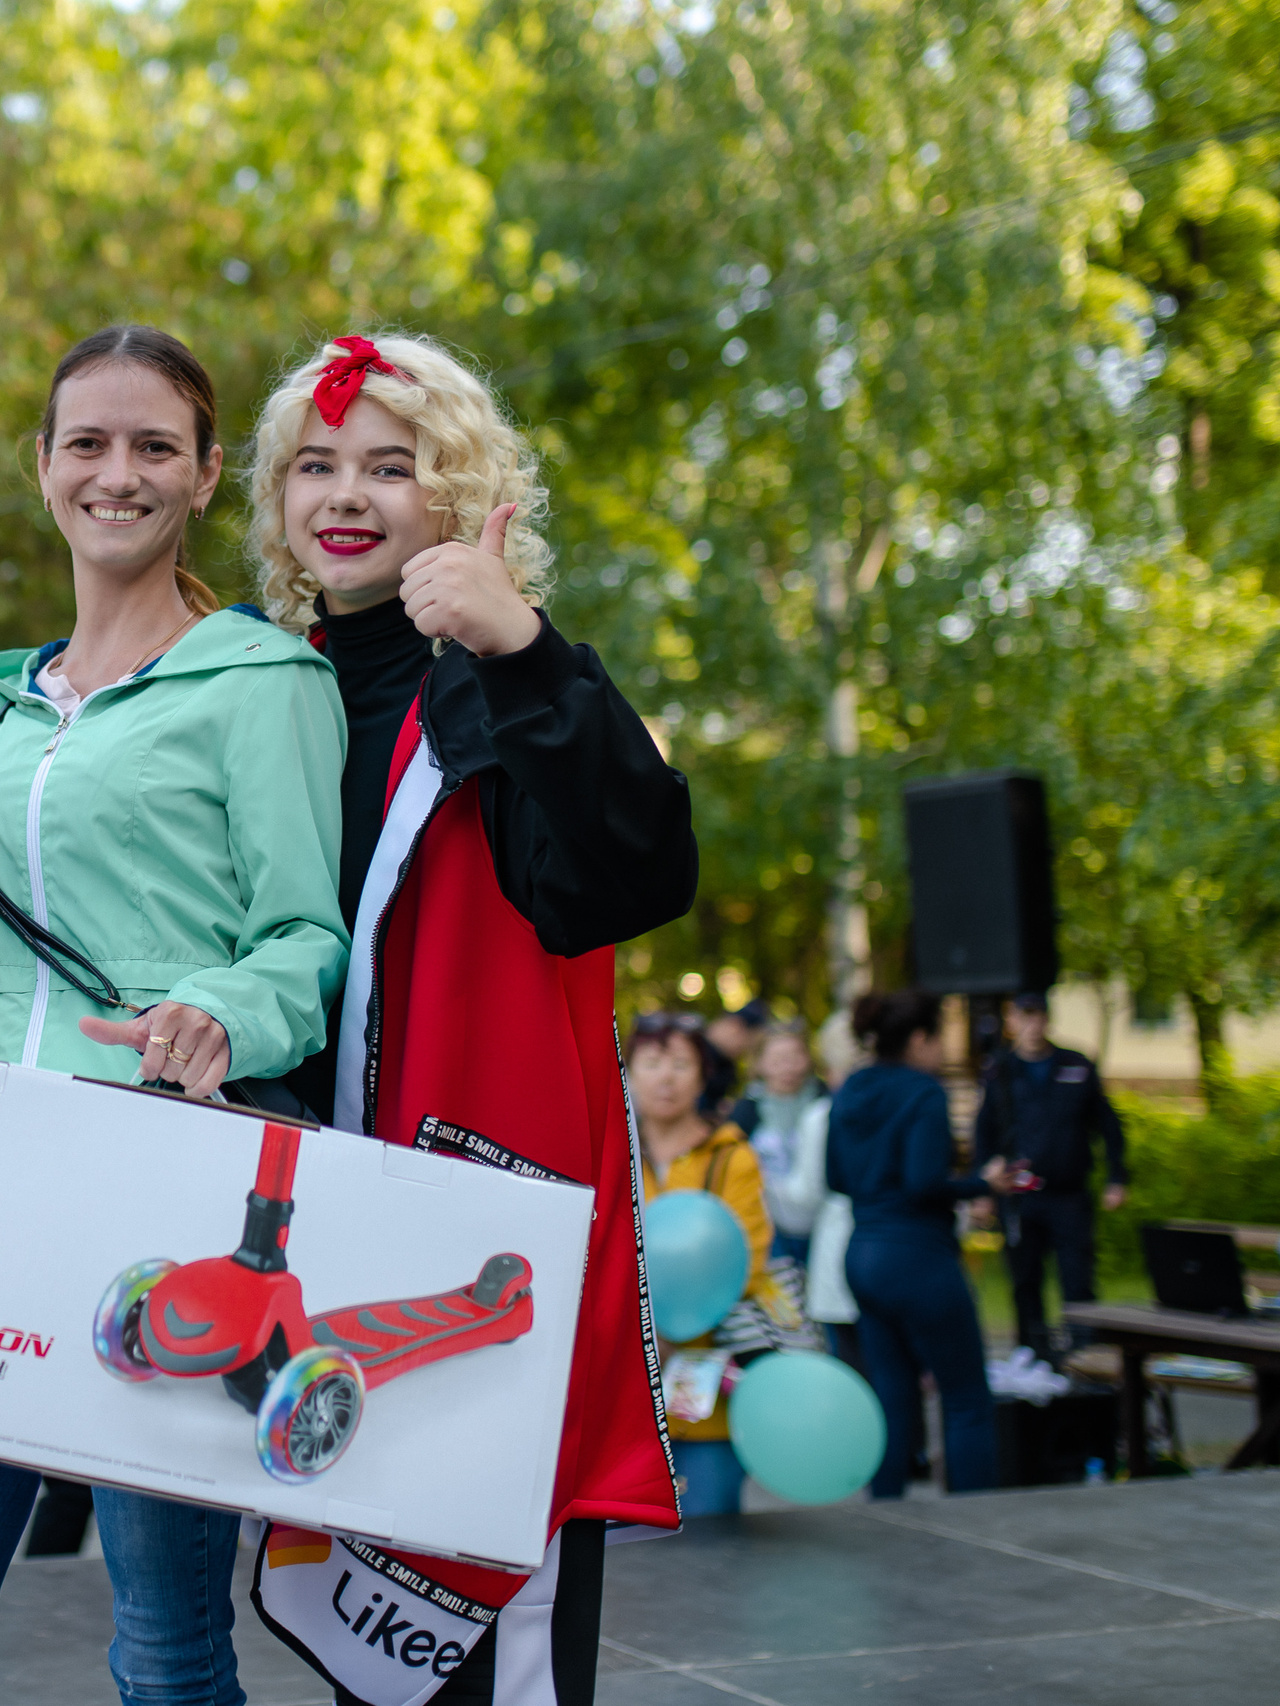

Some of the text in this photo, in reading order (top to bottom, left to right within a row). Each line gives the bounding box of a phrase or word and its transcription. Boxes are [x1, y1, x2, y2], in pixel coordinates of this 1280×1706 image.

[464, 1135, 511, 1167] SMILE
[636, 1252, 648, 1295] SMILE
[640, 1297, 653, 1341] SMILE
[643, 1342, 660, 1387] SMILE
[652, 1387, 669, 1432] SMILE
[343, 1537, 499, 1624] SMILE SMILE SMILE SMILE
[332, 1569, 466, 1679] Likee
